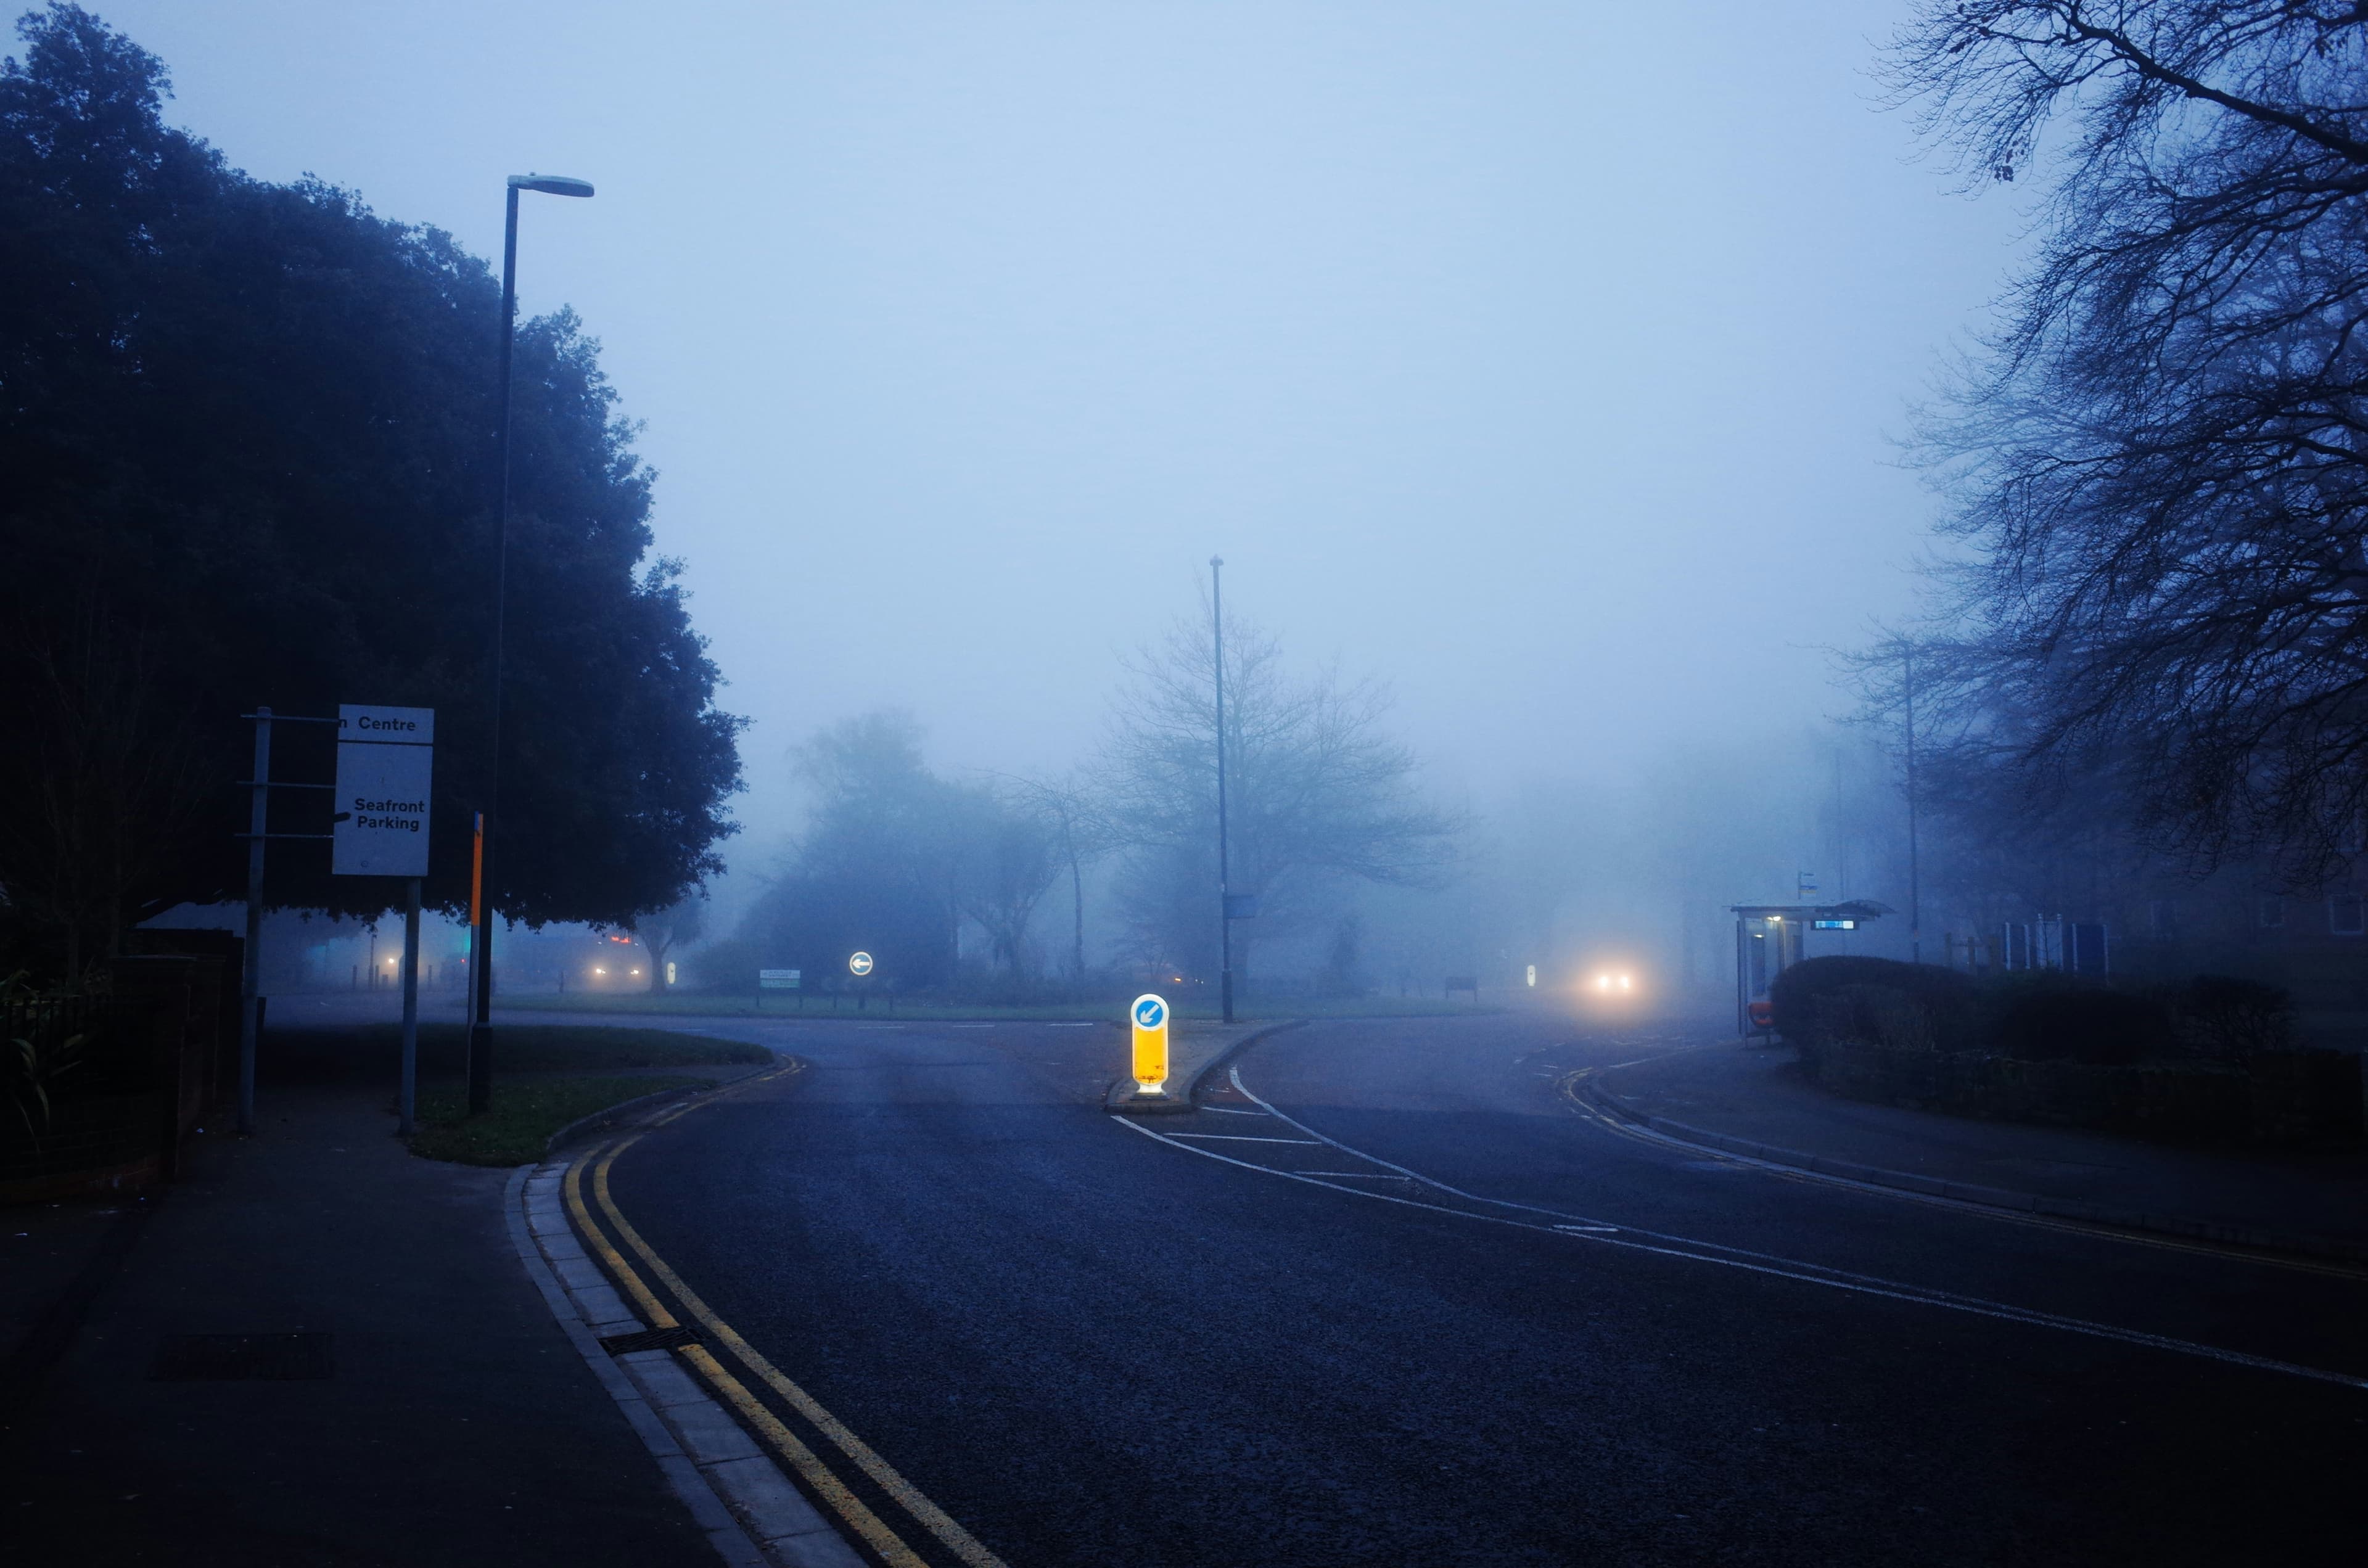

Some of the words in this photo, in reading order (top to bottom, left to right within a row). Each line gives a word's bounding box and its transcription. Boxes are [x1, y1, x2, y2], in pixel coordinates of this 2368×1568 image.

[358, 716, 416, 731] Centre
[355, 798, 424, 812] Seafront
[358, 816, 419, 832] Parking
